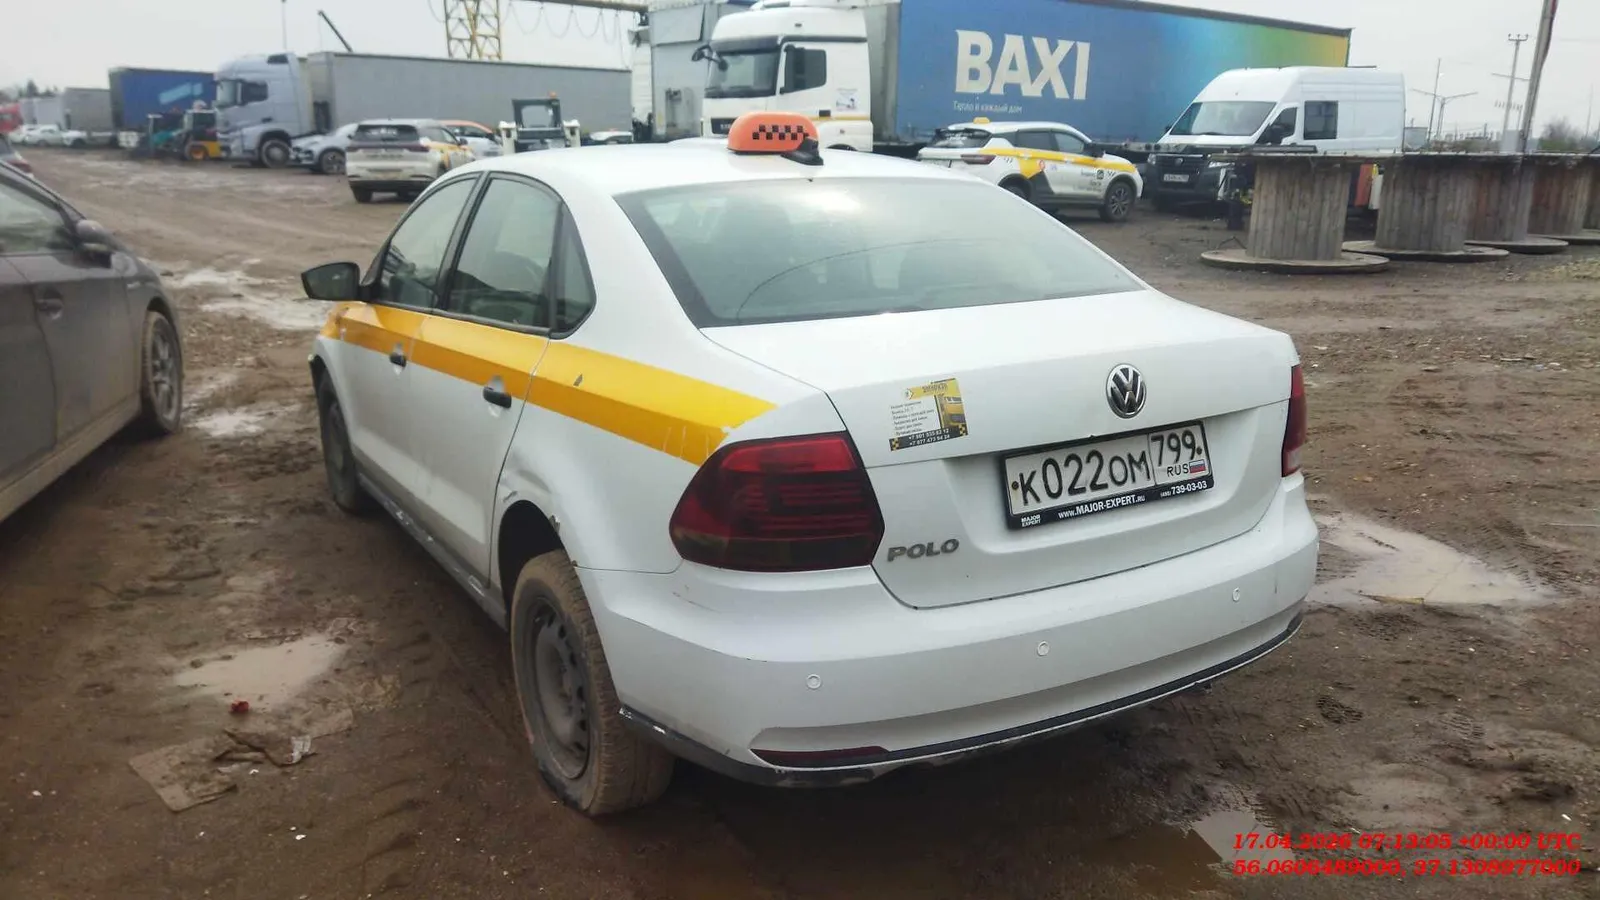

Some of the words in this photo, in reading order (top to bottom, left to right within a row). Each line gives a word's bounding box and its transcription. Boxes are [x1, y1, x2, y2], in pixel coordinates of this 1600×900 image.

[954, 29, 1091, 100] BAXI
[1151, 429, 1197, 467] 799
[1167, 461, 1189, 477] RUS
[1171, 481, 1208, 495] 739-03-03
[1021, 514, 1041, 523] MAJOR
[1022, 519, 1041, 527] EXPERT
[887, 539, 960, 563] POLO
